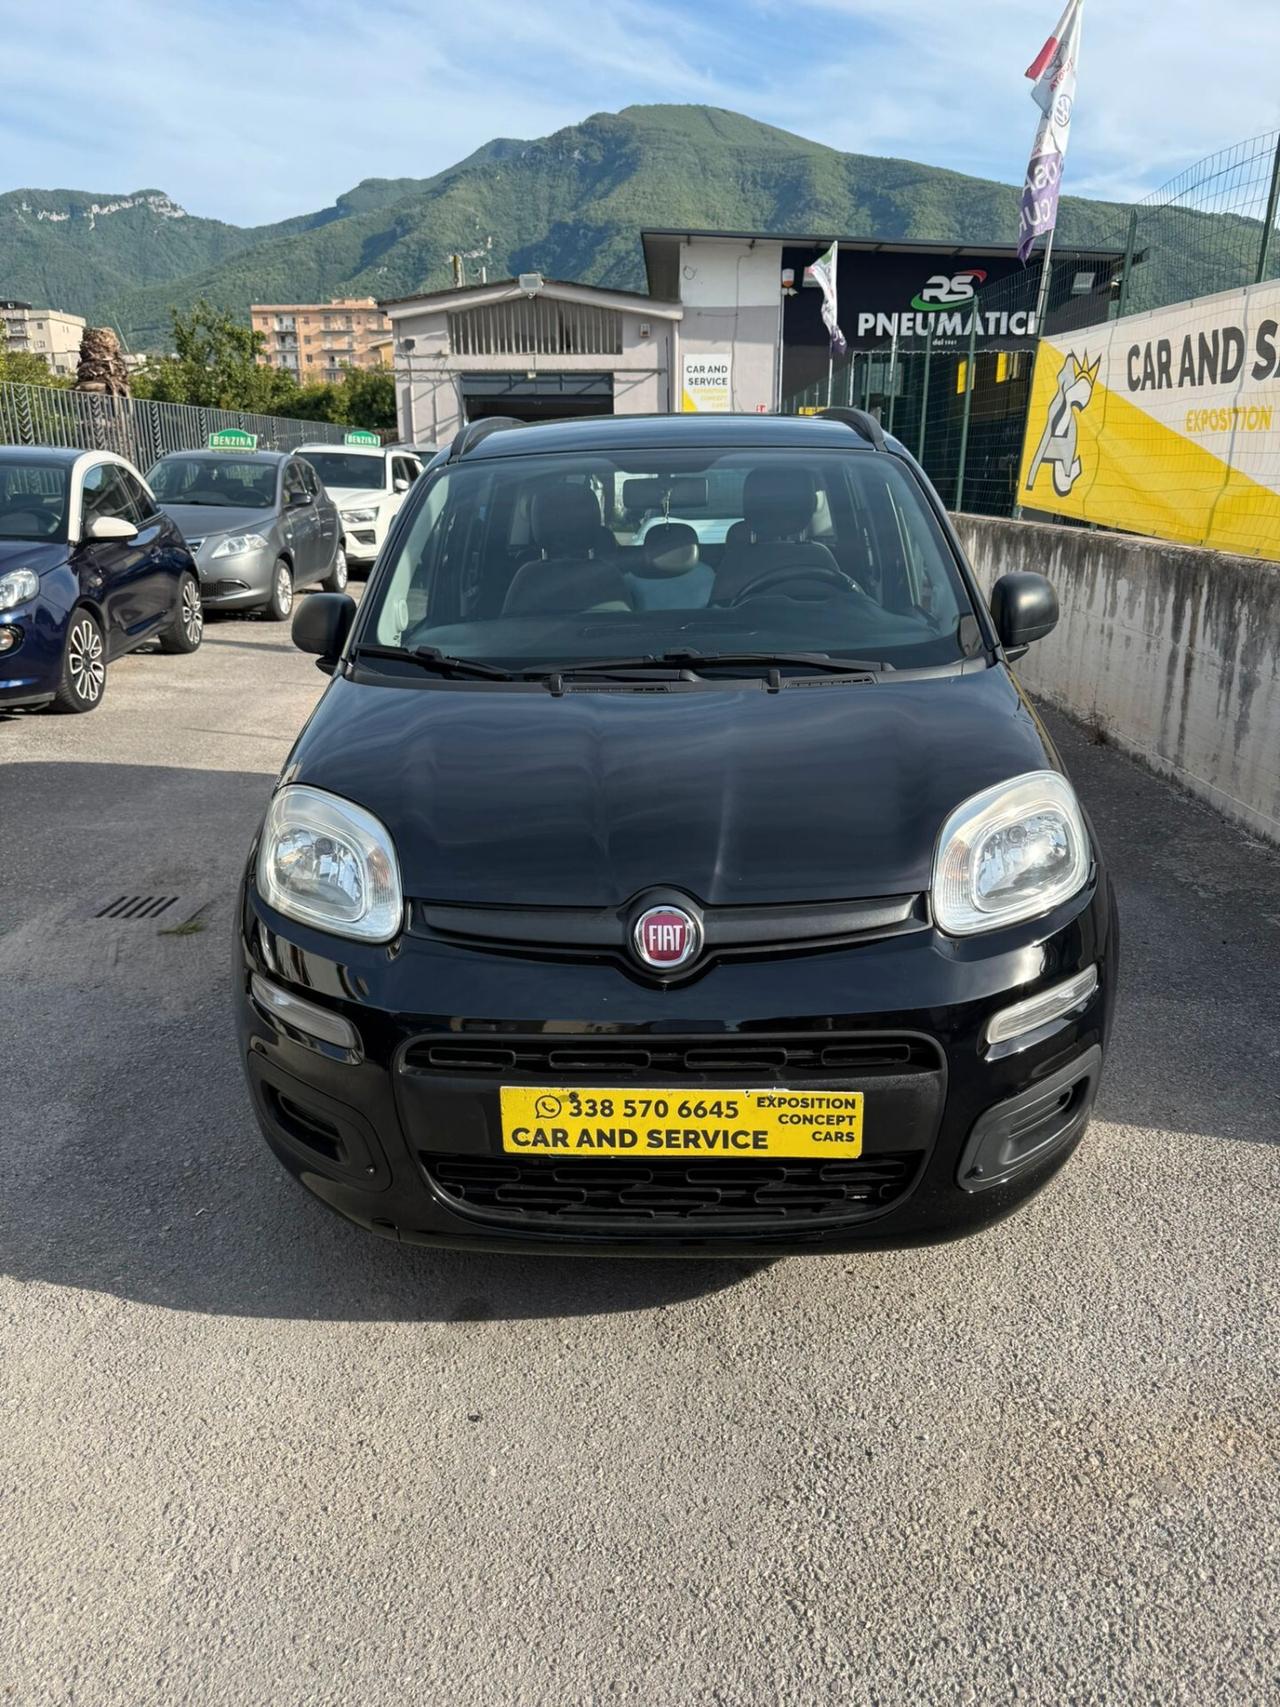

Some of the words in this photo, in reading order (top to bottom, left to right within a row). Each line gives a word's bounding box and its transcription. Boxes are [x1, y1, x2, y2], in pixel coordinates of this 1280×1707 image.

[922, 275, 974, 302] RS
[858, 311, 1038, 337] PNEUMATICI
[1127, 340, 1173, 392] CAR
[1178, 326, 1245, 388] AND
[1251, 319, 1280, 381] S
[686, 365, 705, 373] CAR
[707, 365, 728, 373] AND
[688, 377, 728, 386] SERVICE
[1185, 405, 1273, 432] EXPOSITION
[213, 436, 252, 446] BENZINA
[648, 925, 683, 951] FIAT
[569, 1099, 614, 1118] 338
[623, 1100, 669, 1118] 570
[678, 1100, 739, 1119] 6645
[757, 1097, 856, 1109] EXPOSITION
[778, 1114, 856, 1126] CONCEPT
[511, 1127, 570, 1147] CAR
[576, 1128, 638, 1148] AND
[647, 1129, 769, 1149] SERVICE
[812, 1131, 855, 1142] CARS
